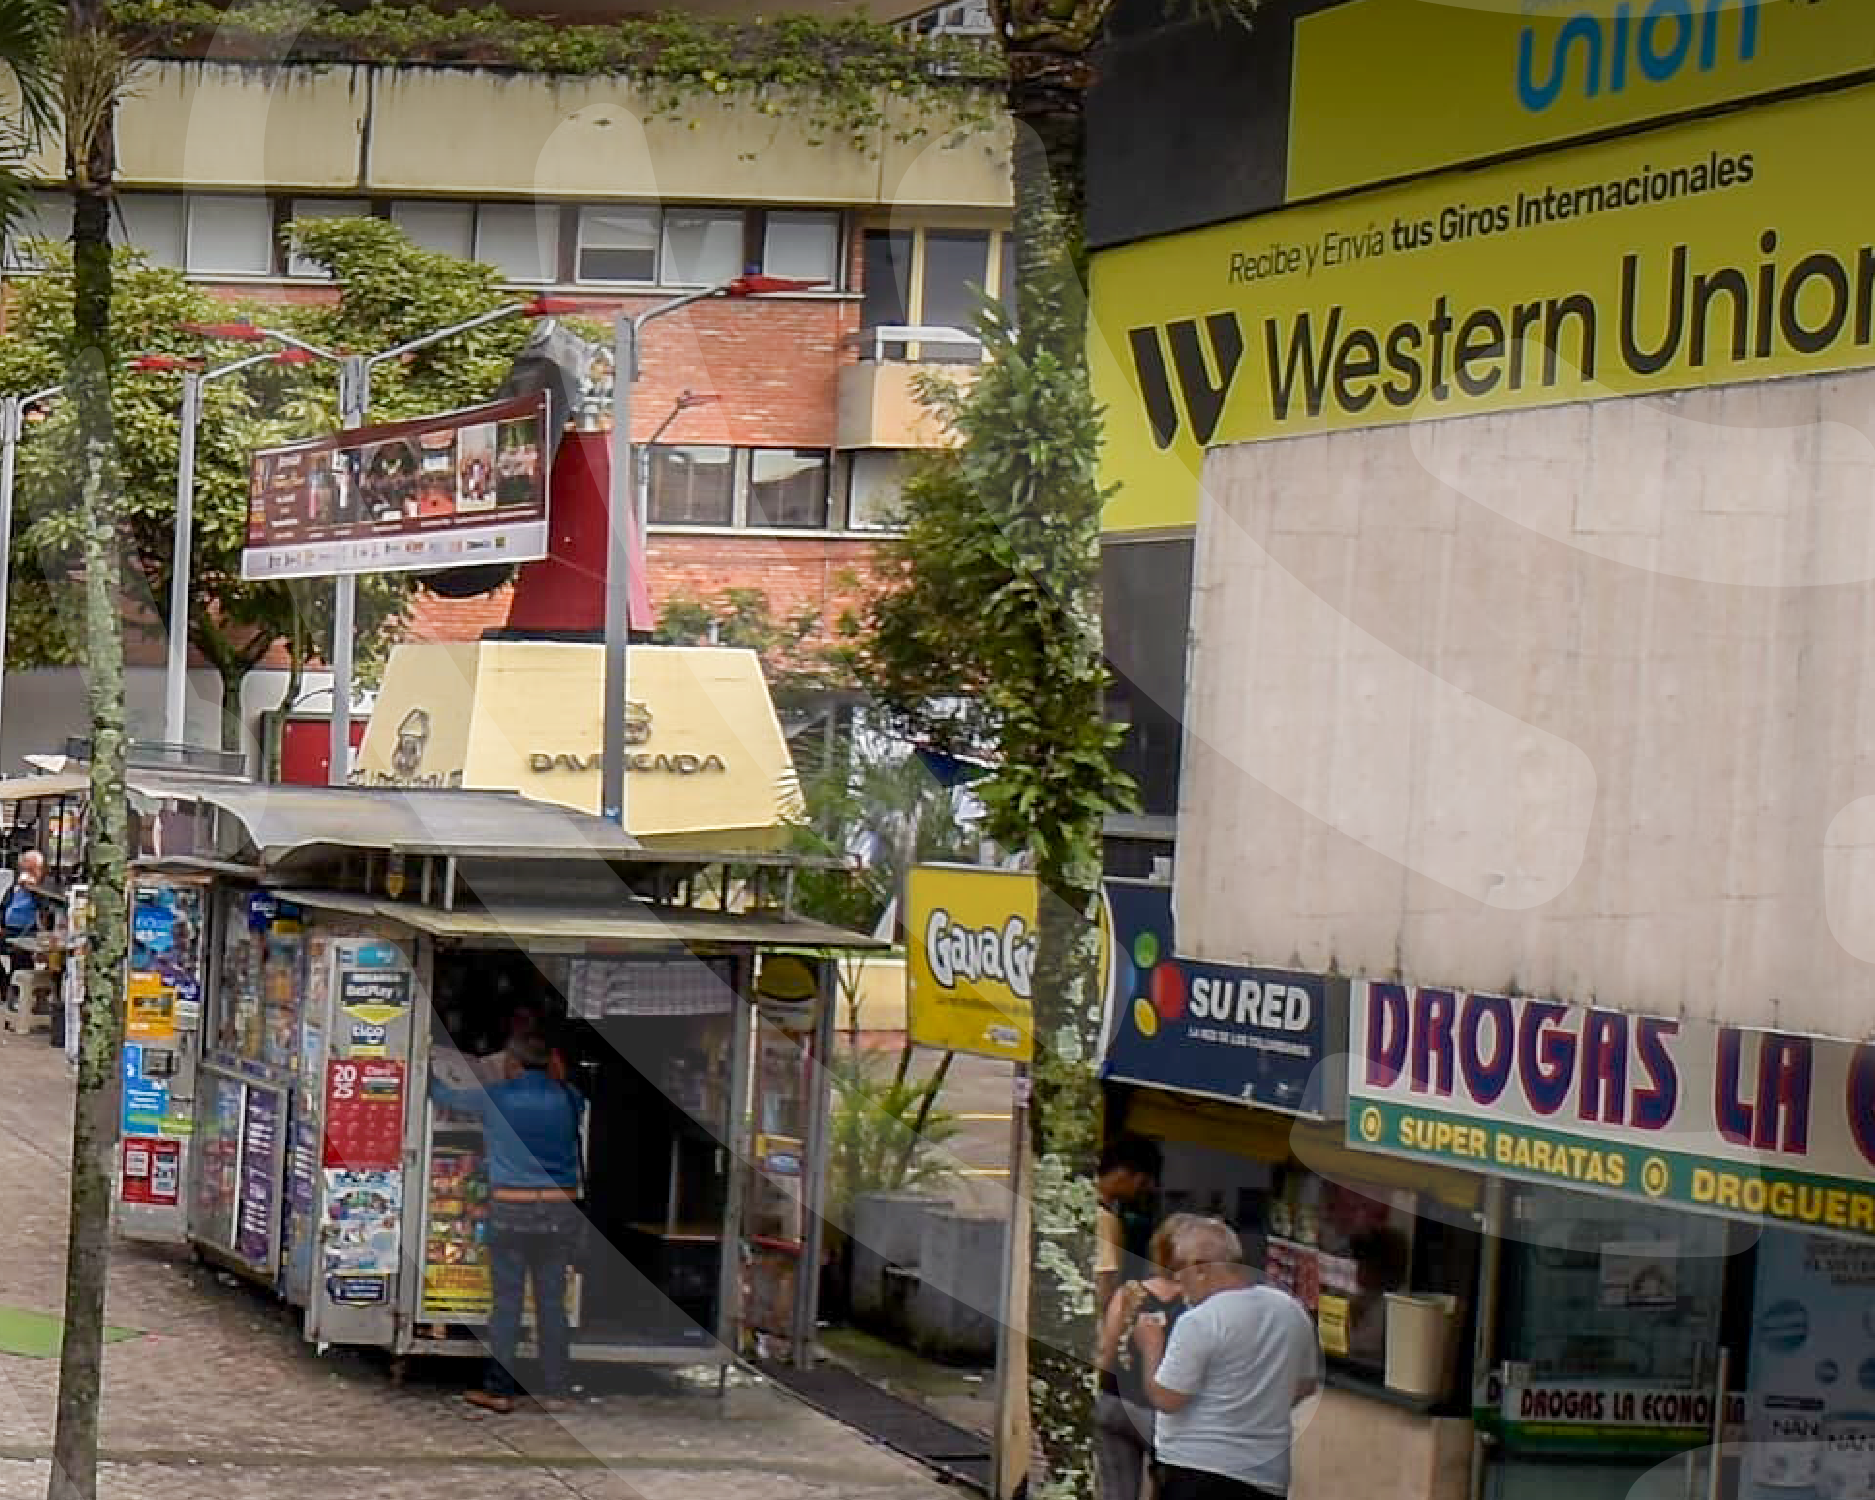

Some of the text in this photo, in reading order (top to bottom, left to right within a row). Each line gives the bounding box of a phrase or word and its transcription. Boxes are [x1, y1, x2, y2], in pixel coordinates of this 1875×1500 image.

[1229, 251, 1302, 286] Recibe
[1303, 248, 1319, 274] y
[1390, 217, 1434, 255] tus
[1439, 200, 1509, 244] Giros
[1515, 151, 1755, 227] Internacionales
[1264, 293, 1596, 422] Western
[1365, 979, 1679, 1131] DROGAS
[1714, 1026, 1812, 1157] LA
[1398, 1115, 1488, 1168] SUPER
[1494, 1132, 1626, 1188] BARATAS
[1520, 1389, 1604, 1421] DROGAS
[1613, 1391, 1636, 1422] LA
